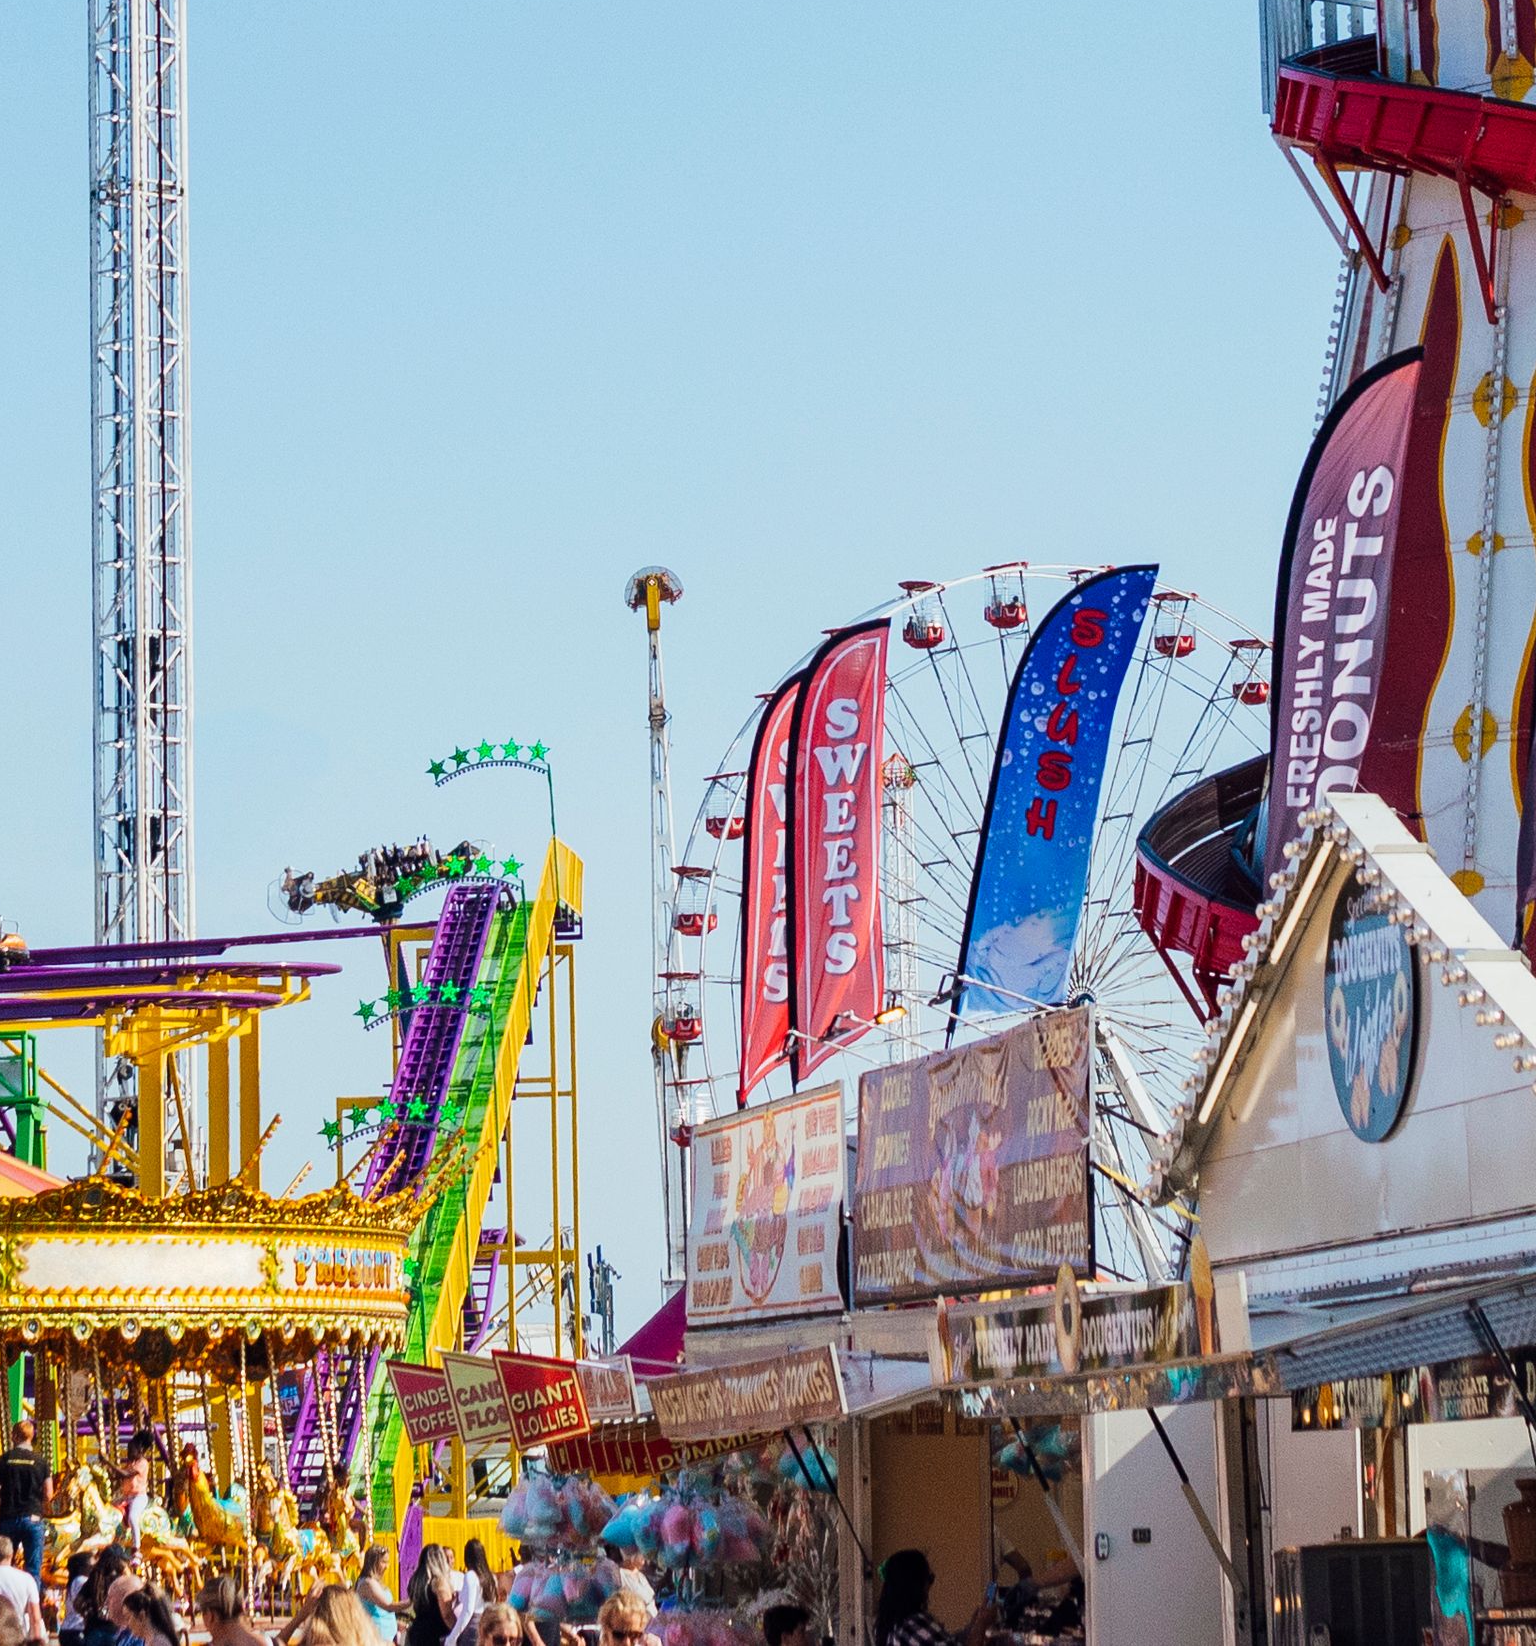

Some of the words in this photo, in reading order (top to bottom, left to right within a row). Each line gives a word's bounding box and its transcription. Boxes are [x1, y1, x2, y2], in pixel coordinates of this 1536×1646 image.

[1302, 515, 1338, 623] MADE
[1315, 465, 1394, 804] DONUTS
[1025, 608, 1108, 842] SLUSH
[1286, 634, 1325, 807] FRESHLY
[813, 698, 867, 975] SWEETS
[1333, 924, 1402, 986] DOUGHNUTS
[1014, 1160, 1047, 1205] LOADED
[295, 1247, 392, 1288] PRESENT
[1081, 1306, 1154, 1359] DOUGHNUTS
[403, 1385, 449, 1413] CINDE
[455, 1380, 502, 1406] CAND
[510, 1378, 575, 1414] GIANT
[783, 1359, 834, 1408] COOKIES
[409, 1410, 457, 1436] TOFFE
[520, 1405, 579, 1438] LOLLIES
